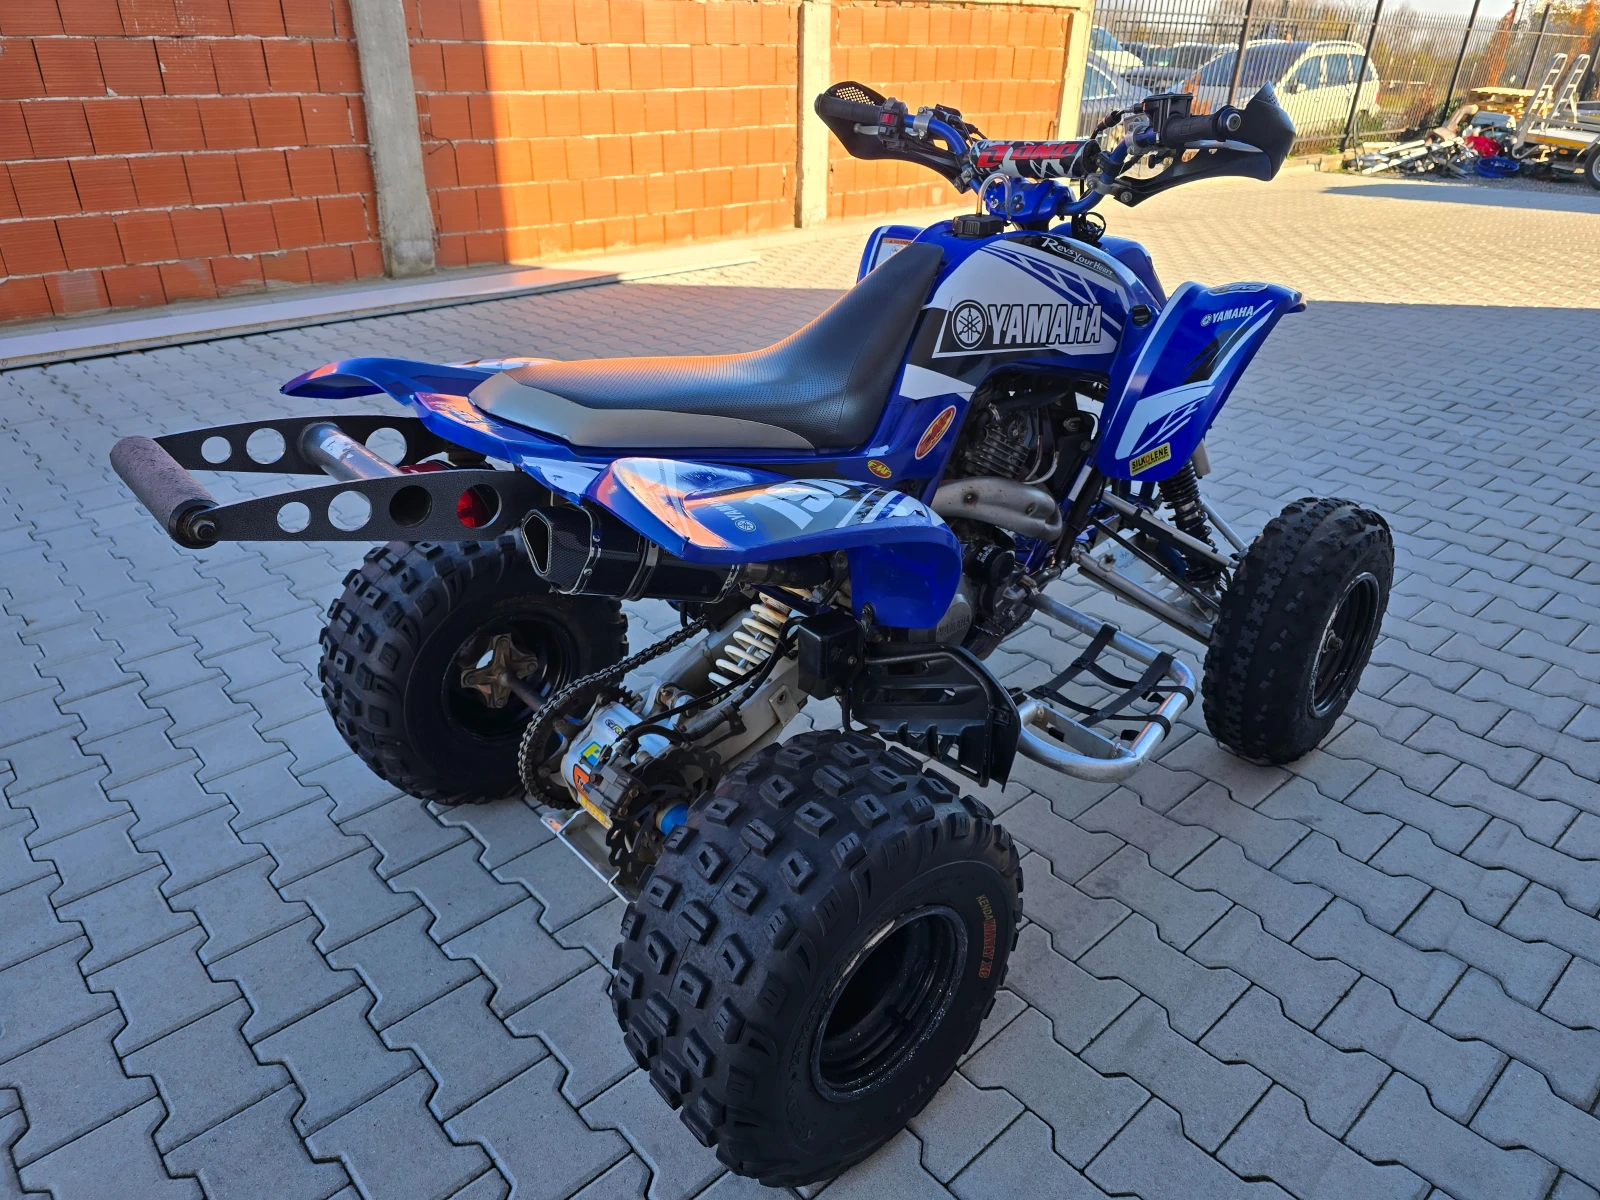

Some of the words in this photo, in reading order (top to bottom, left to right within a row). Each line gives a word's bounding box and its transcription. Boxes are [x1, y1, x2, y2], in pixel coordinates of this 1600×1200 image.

[1041, 236, 1075, 256] Revs
[1074, 251, 1095, 268] Your
[988, 304, 1102, 345] YAMAHA
[1212, 305, 1254, 324] YAMAHA
[867, 460, 892, 476] FMF
[1131, 445, 1169, 469] SILKOLENE
[976, 894, 994, 920] KENDA
